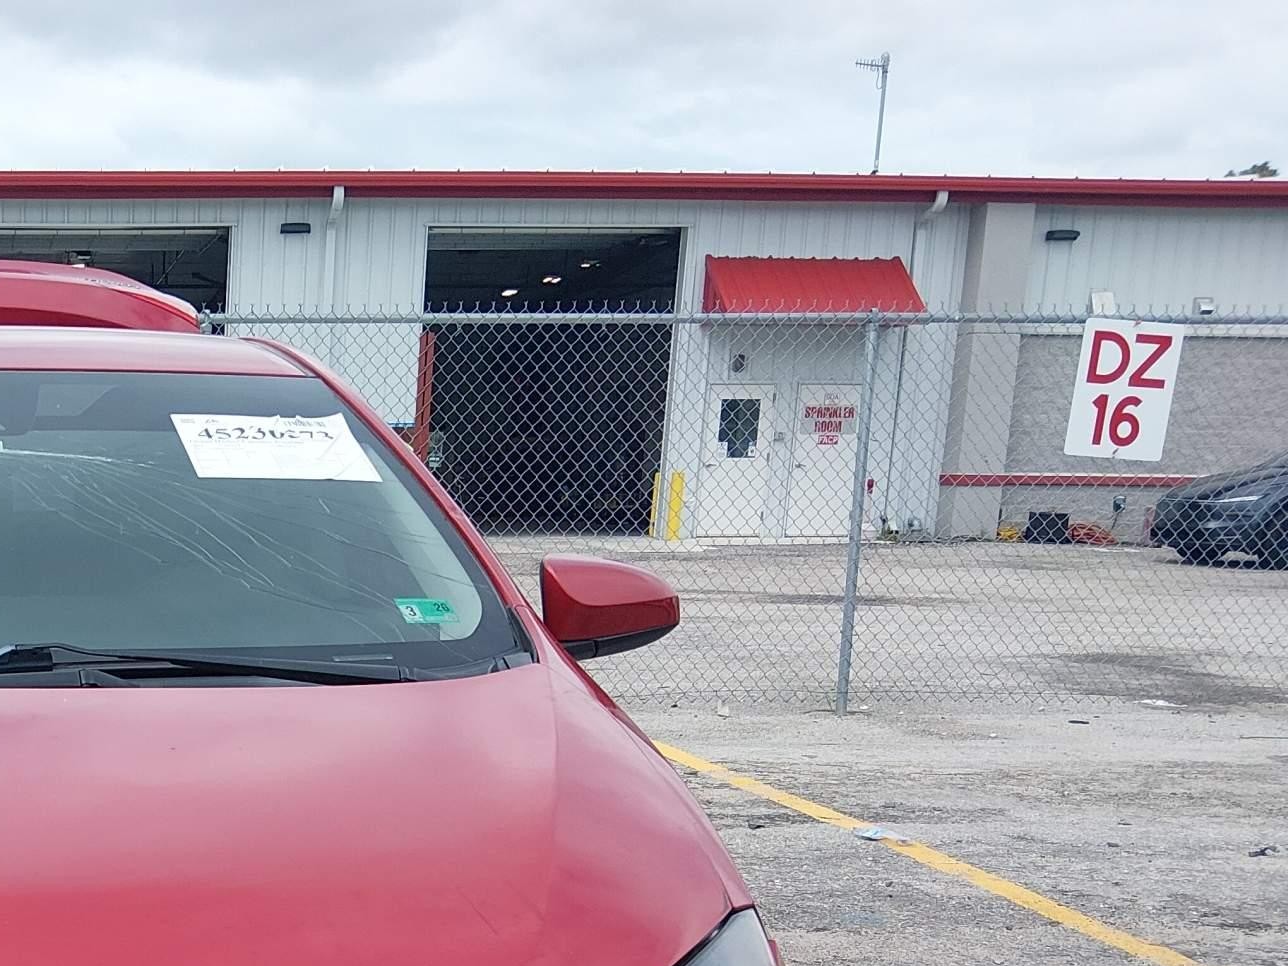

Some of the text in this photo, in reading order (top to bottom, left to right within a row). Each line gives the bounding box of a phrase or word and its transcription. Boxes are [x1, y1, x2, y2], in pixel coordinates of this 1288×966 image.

[1086, 330, 1173, 389] DZ
[804, 406, 854, 418] SPRINKLER
[814, 420, 841, 432] ROOM
[1092, 394, 1143, 447] 16
[405, 605, 416, 616] 3
